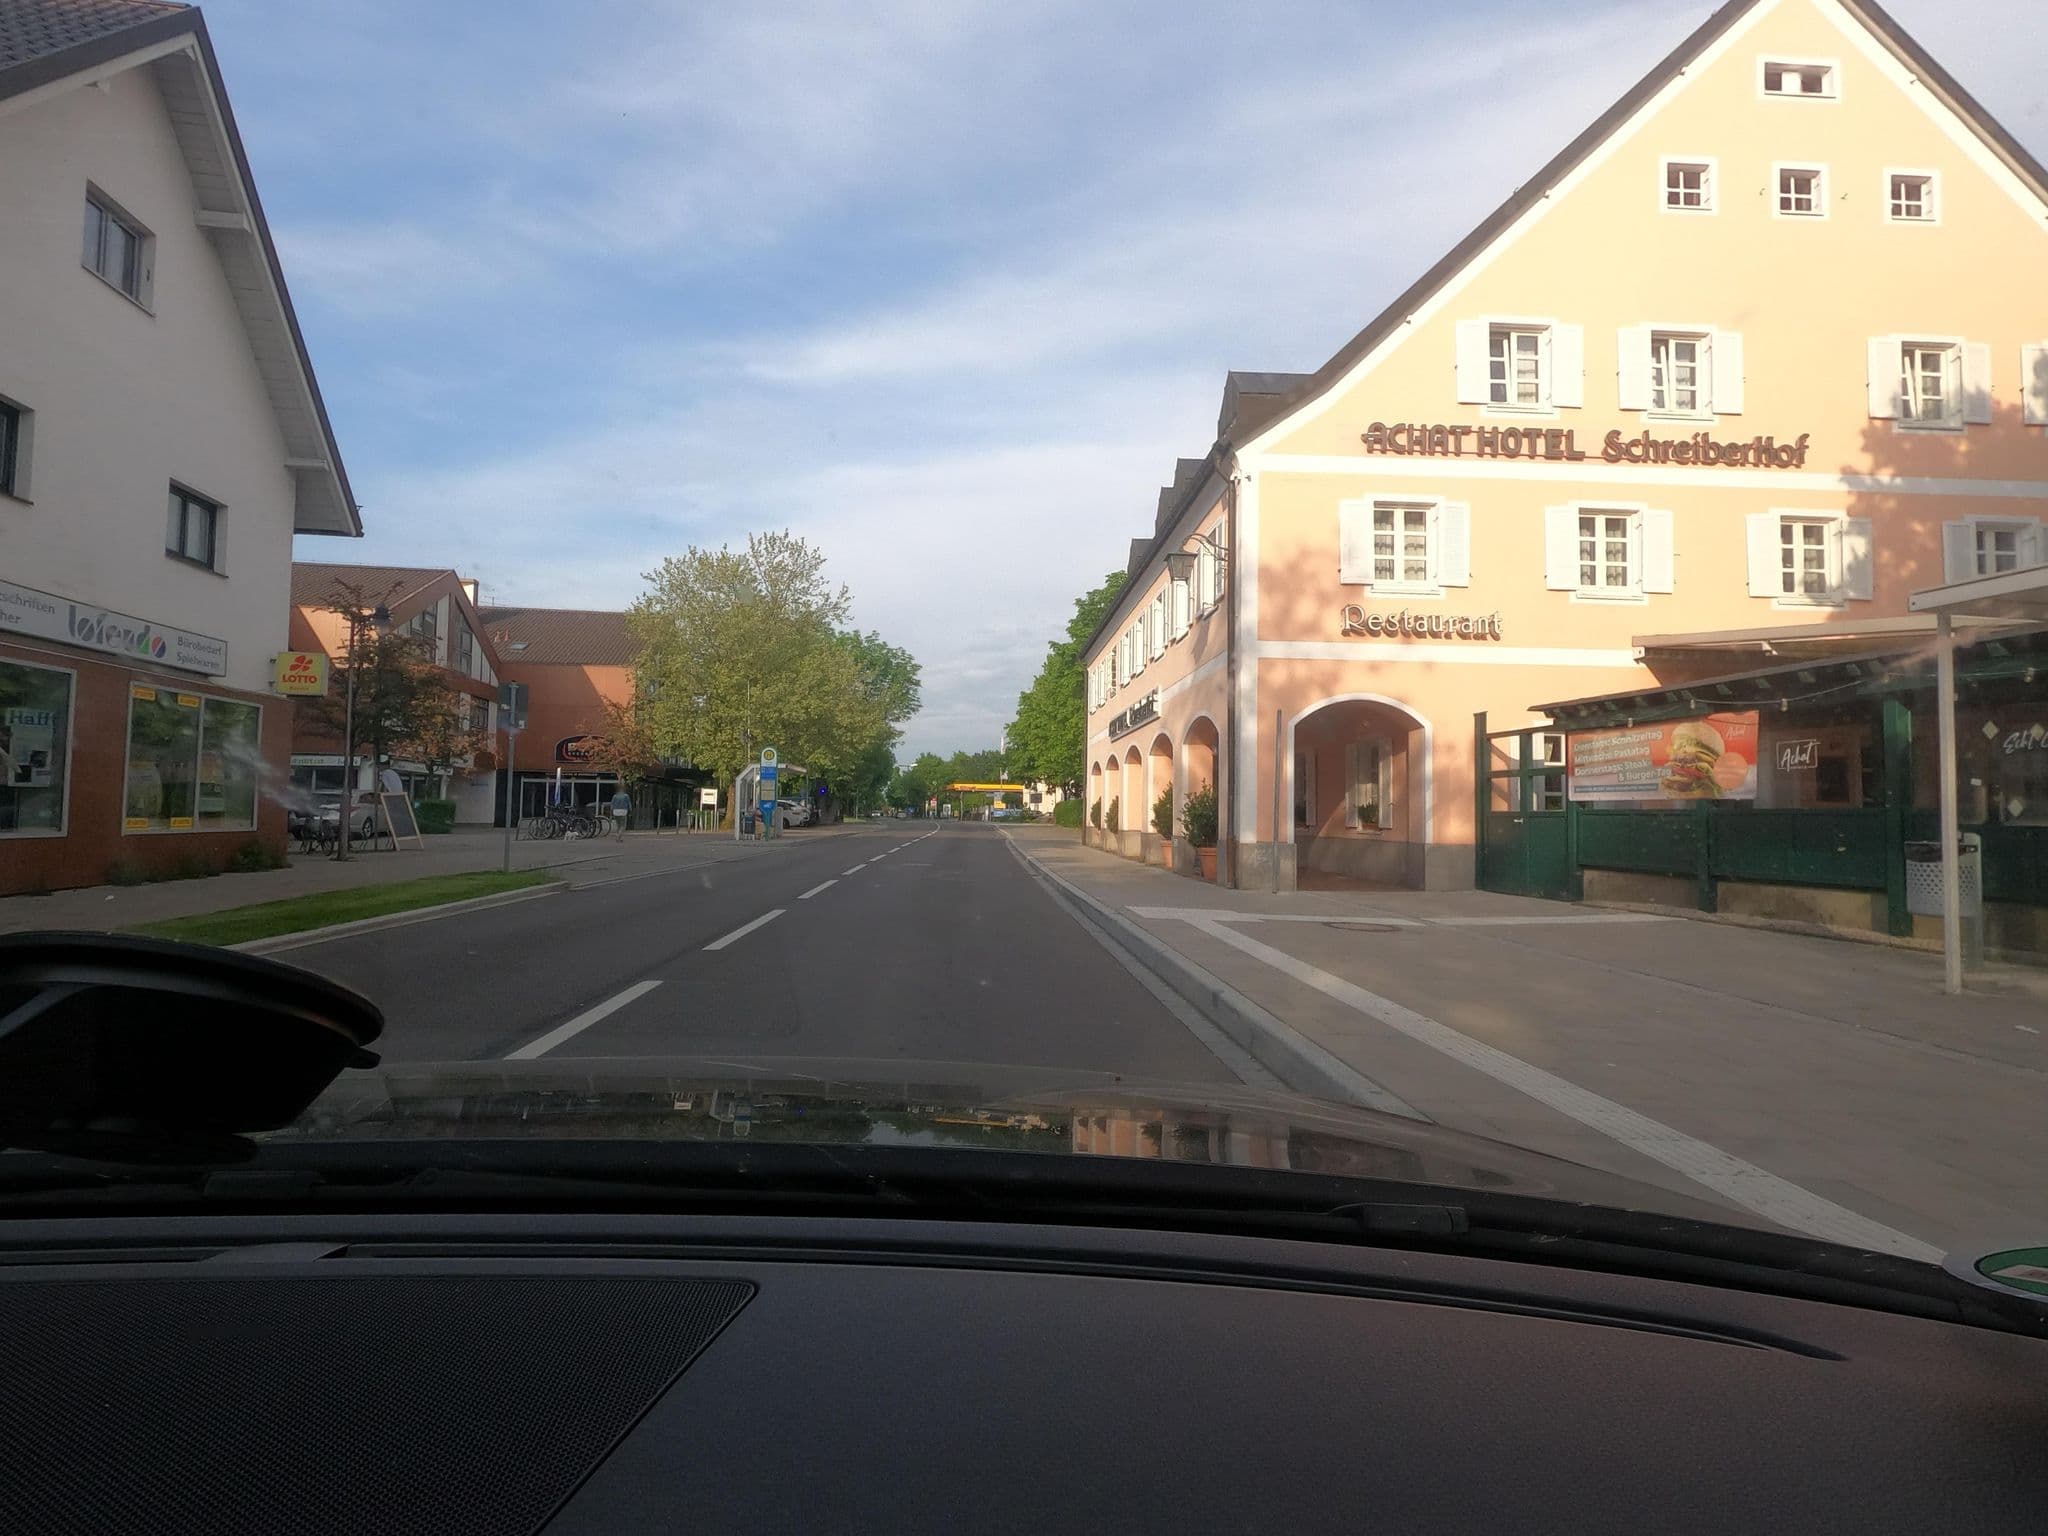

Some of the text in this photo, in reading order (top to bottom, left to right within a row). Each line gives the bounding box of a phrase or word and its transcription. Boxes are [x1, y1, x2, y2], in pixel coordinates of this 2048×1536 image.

[1361, 421, 1472, 457] ACHAT
[1476, 425, 1586, 461] HOTEL
[1341, 603, 1503, 642] Restaurant
[282, 674, 317, 684] LOTTO
